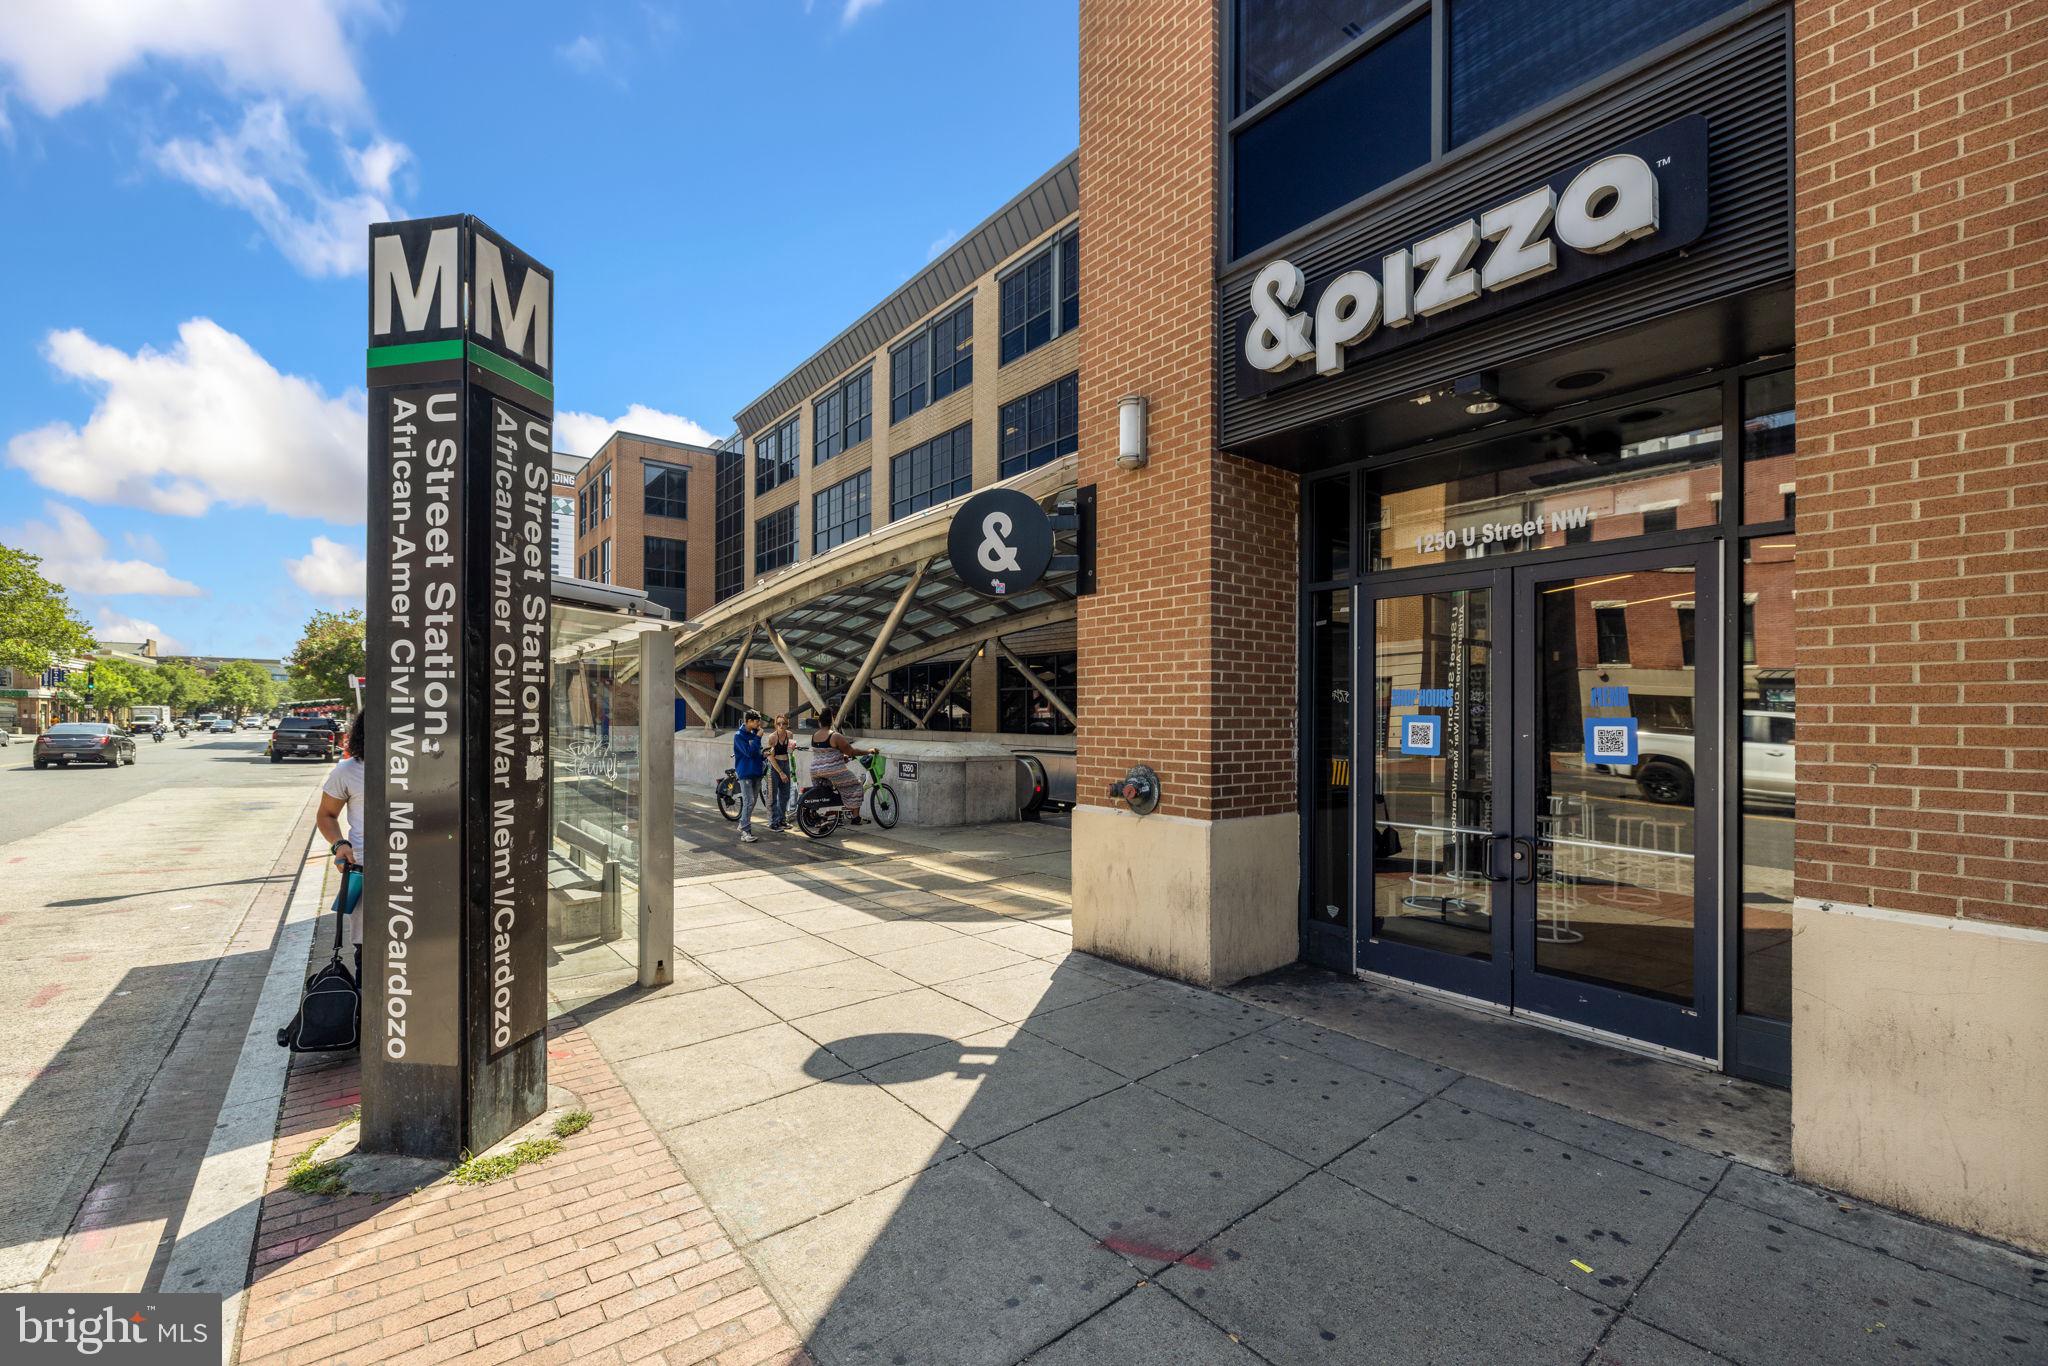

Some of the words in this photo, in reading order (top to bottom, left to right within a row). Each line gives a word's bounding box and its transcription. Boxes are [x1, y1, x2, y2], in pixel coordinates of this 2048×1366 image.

[374, 226, 458, 335] M
[475, 232, 550, 369] M
[426, 393, 457, 422] U
[524, 421, 549, 453] U
[390, 398, 417, 628] African-Amer
[425, 438, 457, 568] Street
[493, 406, 518, 634] African-Amer
[523, 464, 548, 583] Street
[552, 472, 575, 485] DING
[977, 511, 1022, 573] &
[1414, 529, 1456, 554] 1250
[1462, 526, 1475, 547] U
[1481, 514, 1545, 544] Street
[1551, 506, 1589, 533] NW
[390, 639, 416, 714] Civil
[424, 582, 456, 735] Station
[493, 643, 516, 715] Civil
[522, 595, 546, 735] Station
[1419, 688, 1454, 707] HOURS
[389, 721, 415, 790] War
[493, 723, 515, 789] War
[387, 802, 414, 1059] Mem'l/Cardozo
[493, 800, 515, 1049] Mem'l/Cardozo
